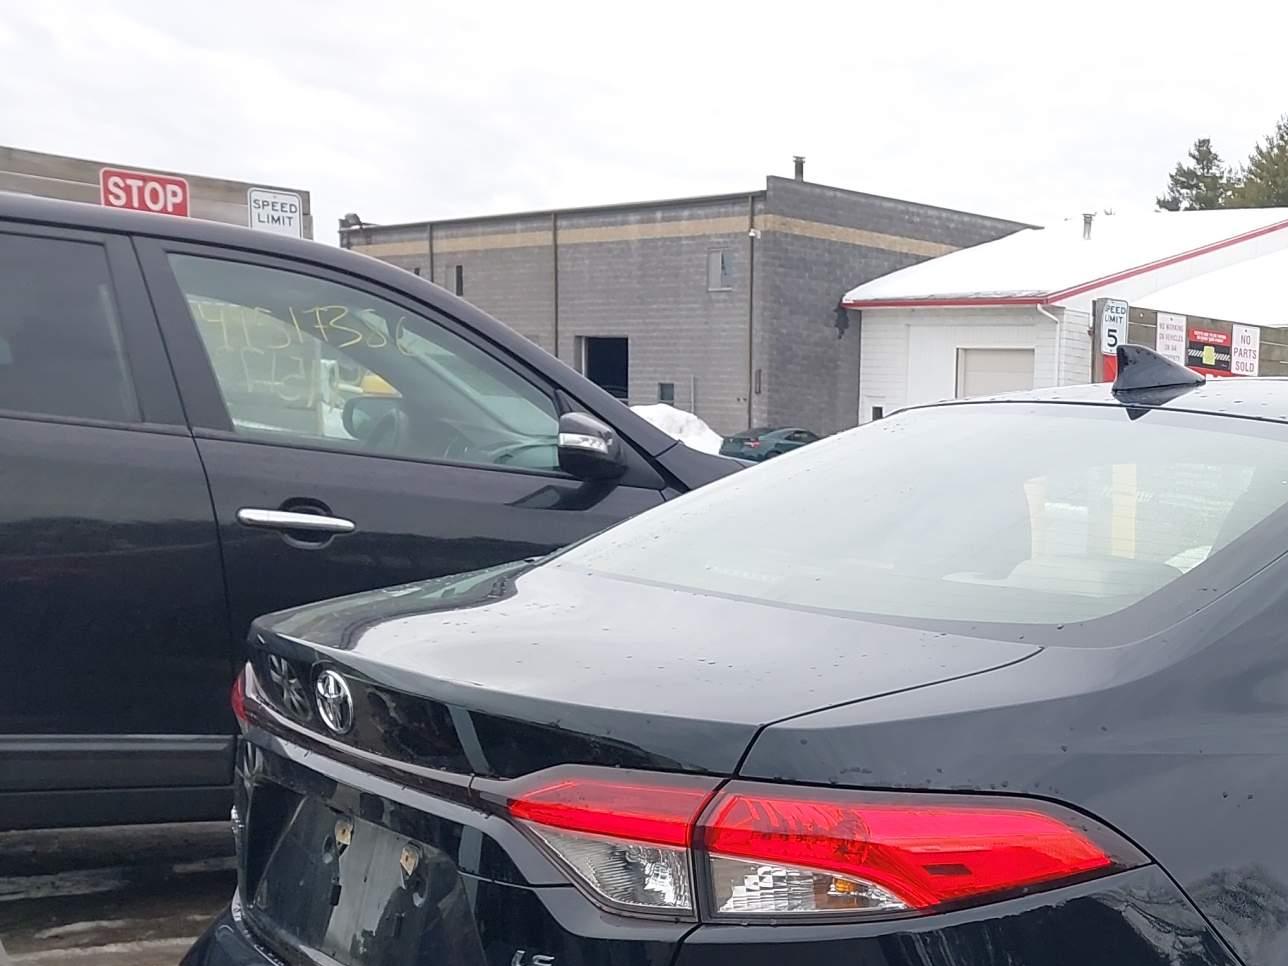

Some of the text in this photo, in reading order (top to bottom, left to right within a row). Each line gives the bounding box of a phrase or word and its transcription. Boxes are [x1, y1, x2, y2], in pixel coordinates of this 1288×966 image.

[107, 176, 183, 212] STOP
[252, 198, 298, 214] SPEED
[257, 212, 294, 227] LIMIT
[1105, 314, 1124, 325] LIMIT
[1107, 328, 1118, 347] 5
[1240, 334, 1251, 345] NO
[1233, 346, 1257, 360] PARTS
[1235, 360, 1255, 373] SOLD
